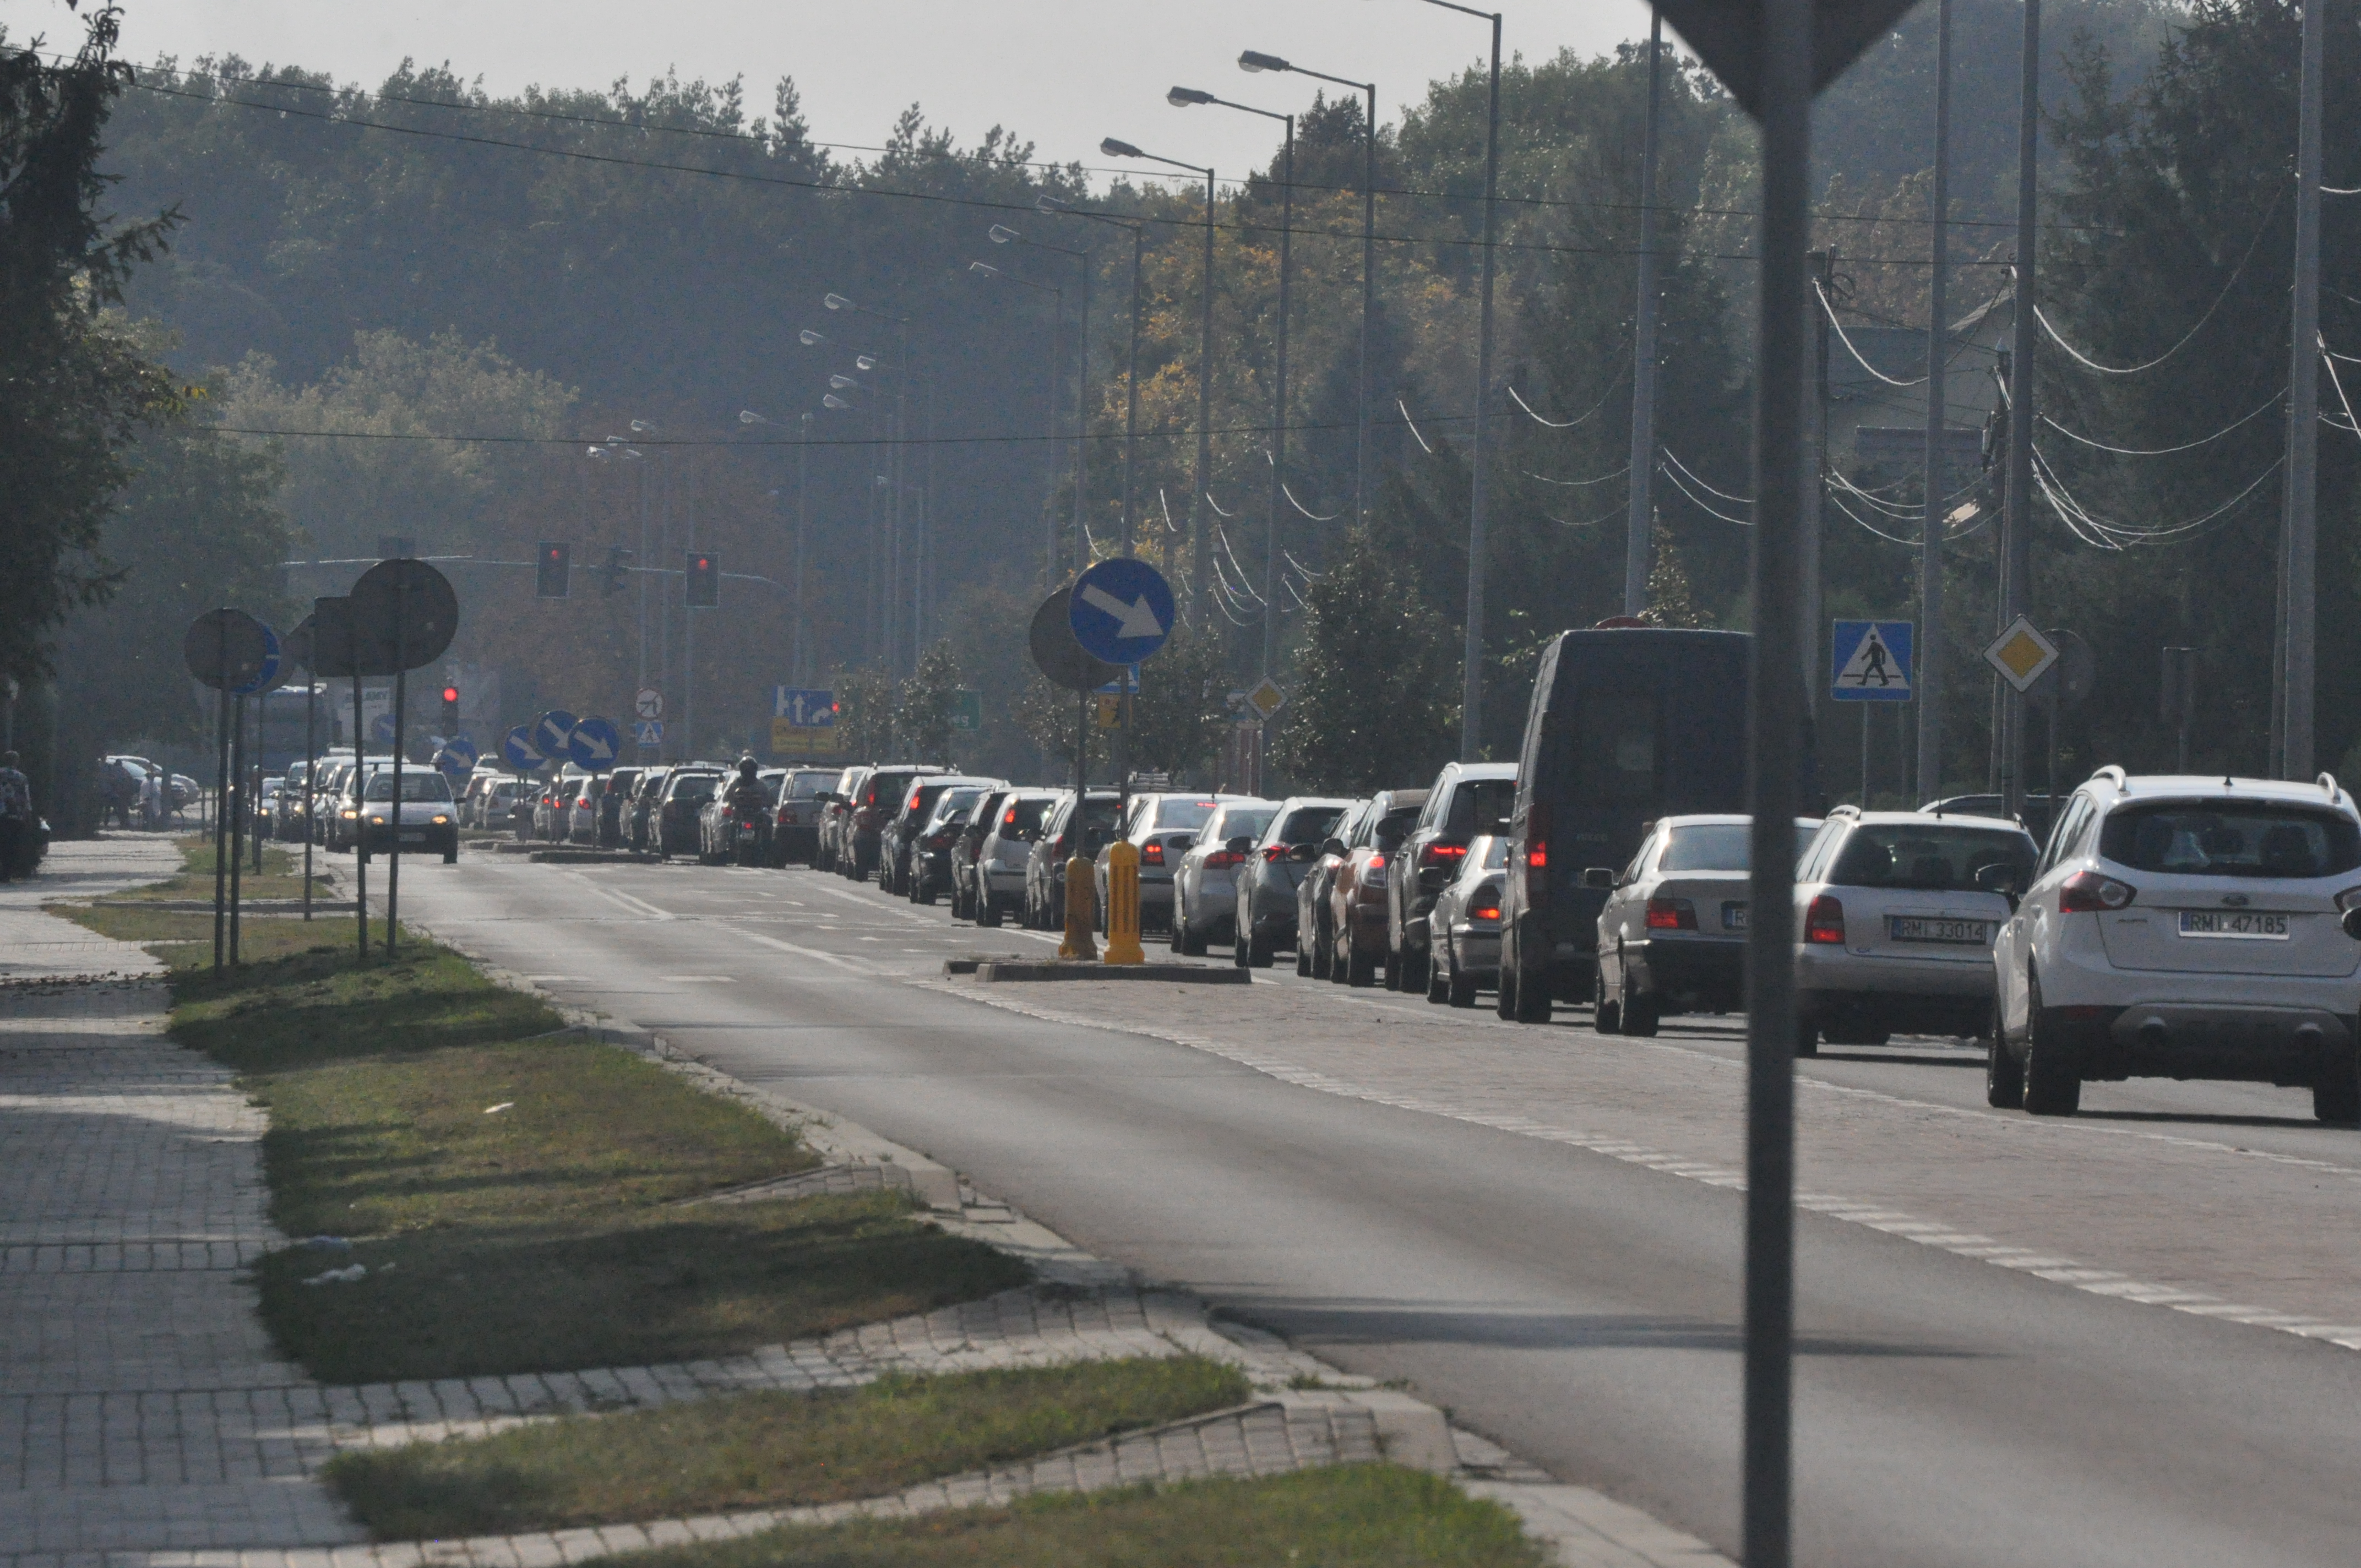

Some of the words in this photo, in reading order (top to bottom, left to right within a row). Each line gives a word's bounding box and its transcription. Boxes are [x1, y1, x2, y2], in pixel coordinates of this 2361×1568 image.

[1935, 922, 1983, 939] 33014
[2190, 914, 2221, 932] RMI
[2231, 916, 2286, 934] 47185
